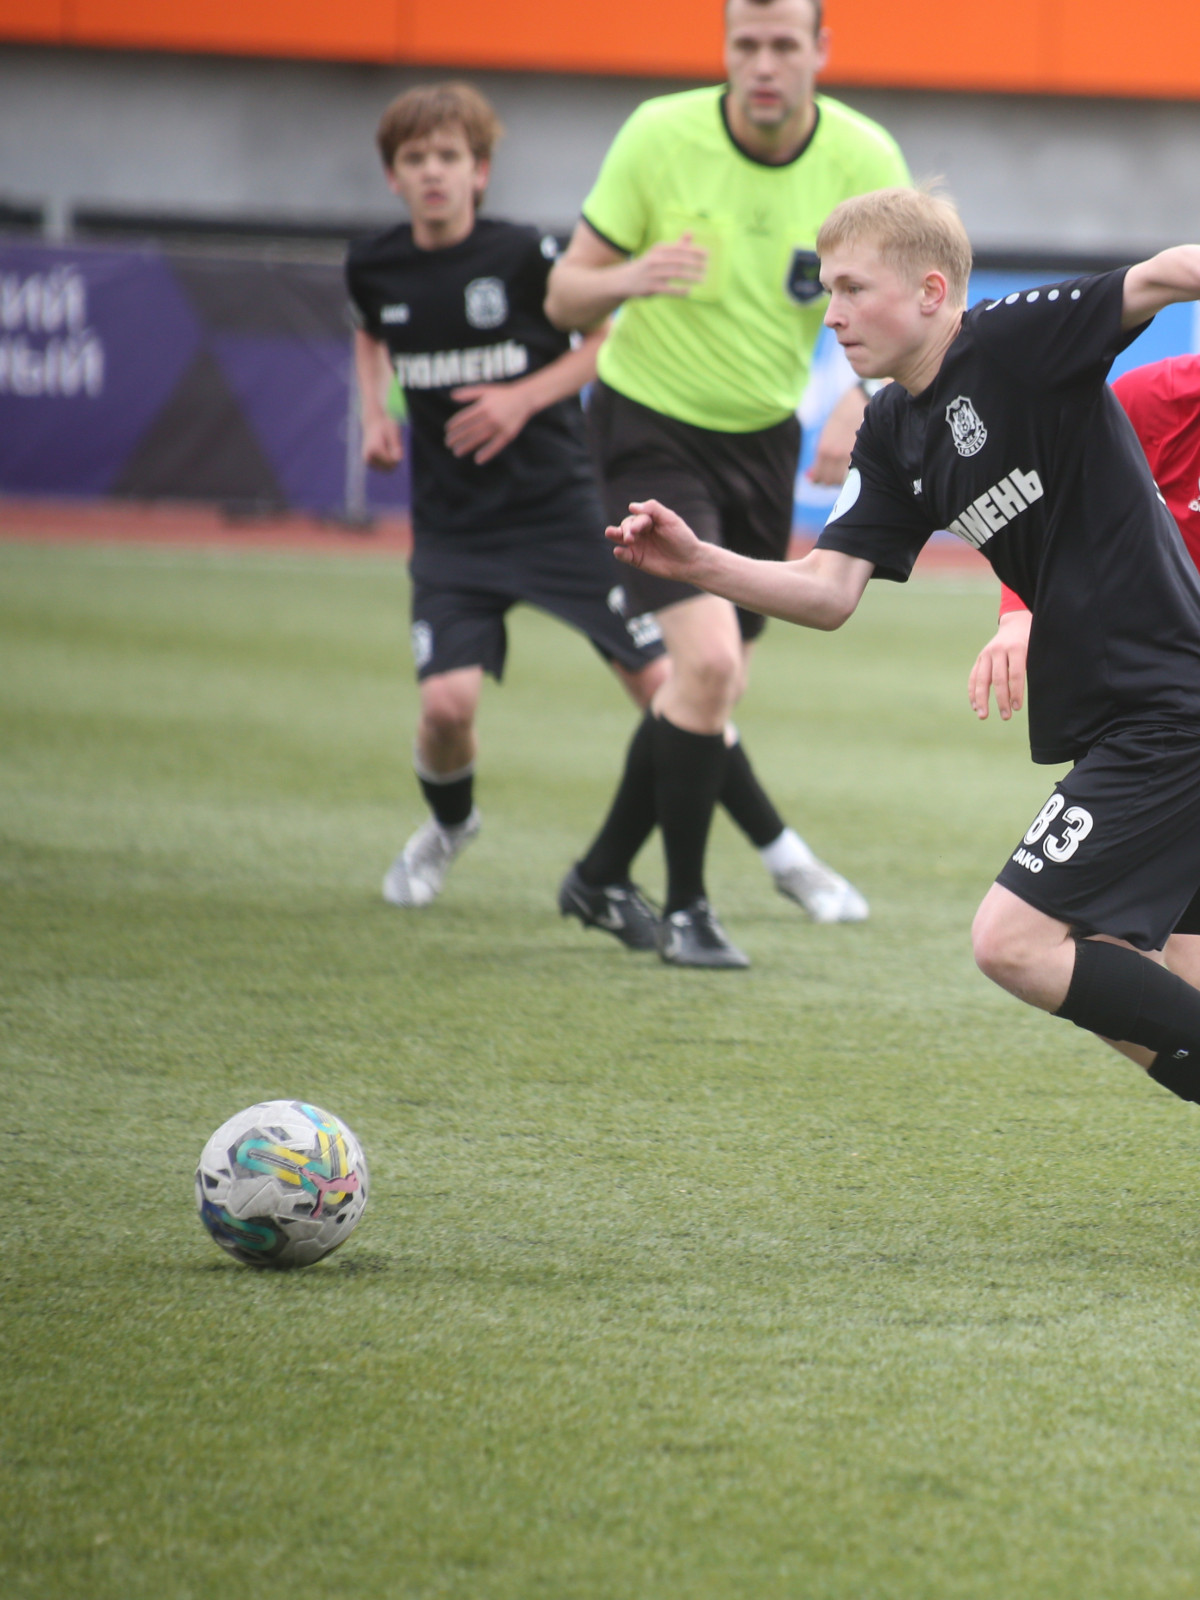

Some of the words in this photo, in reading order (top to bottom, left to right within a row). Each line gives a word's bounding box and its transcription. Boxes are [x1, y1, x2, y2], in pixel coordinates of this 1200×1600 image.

[0, 265, 86, 332] ИЙ
[1012, 847, 1044, 873] JAKO
[1023, 793, 1094, 863] 83
